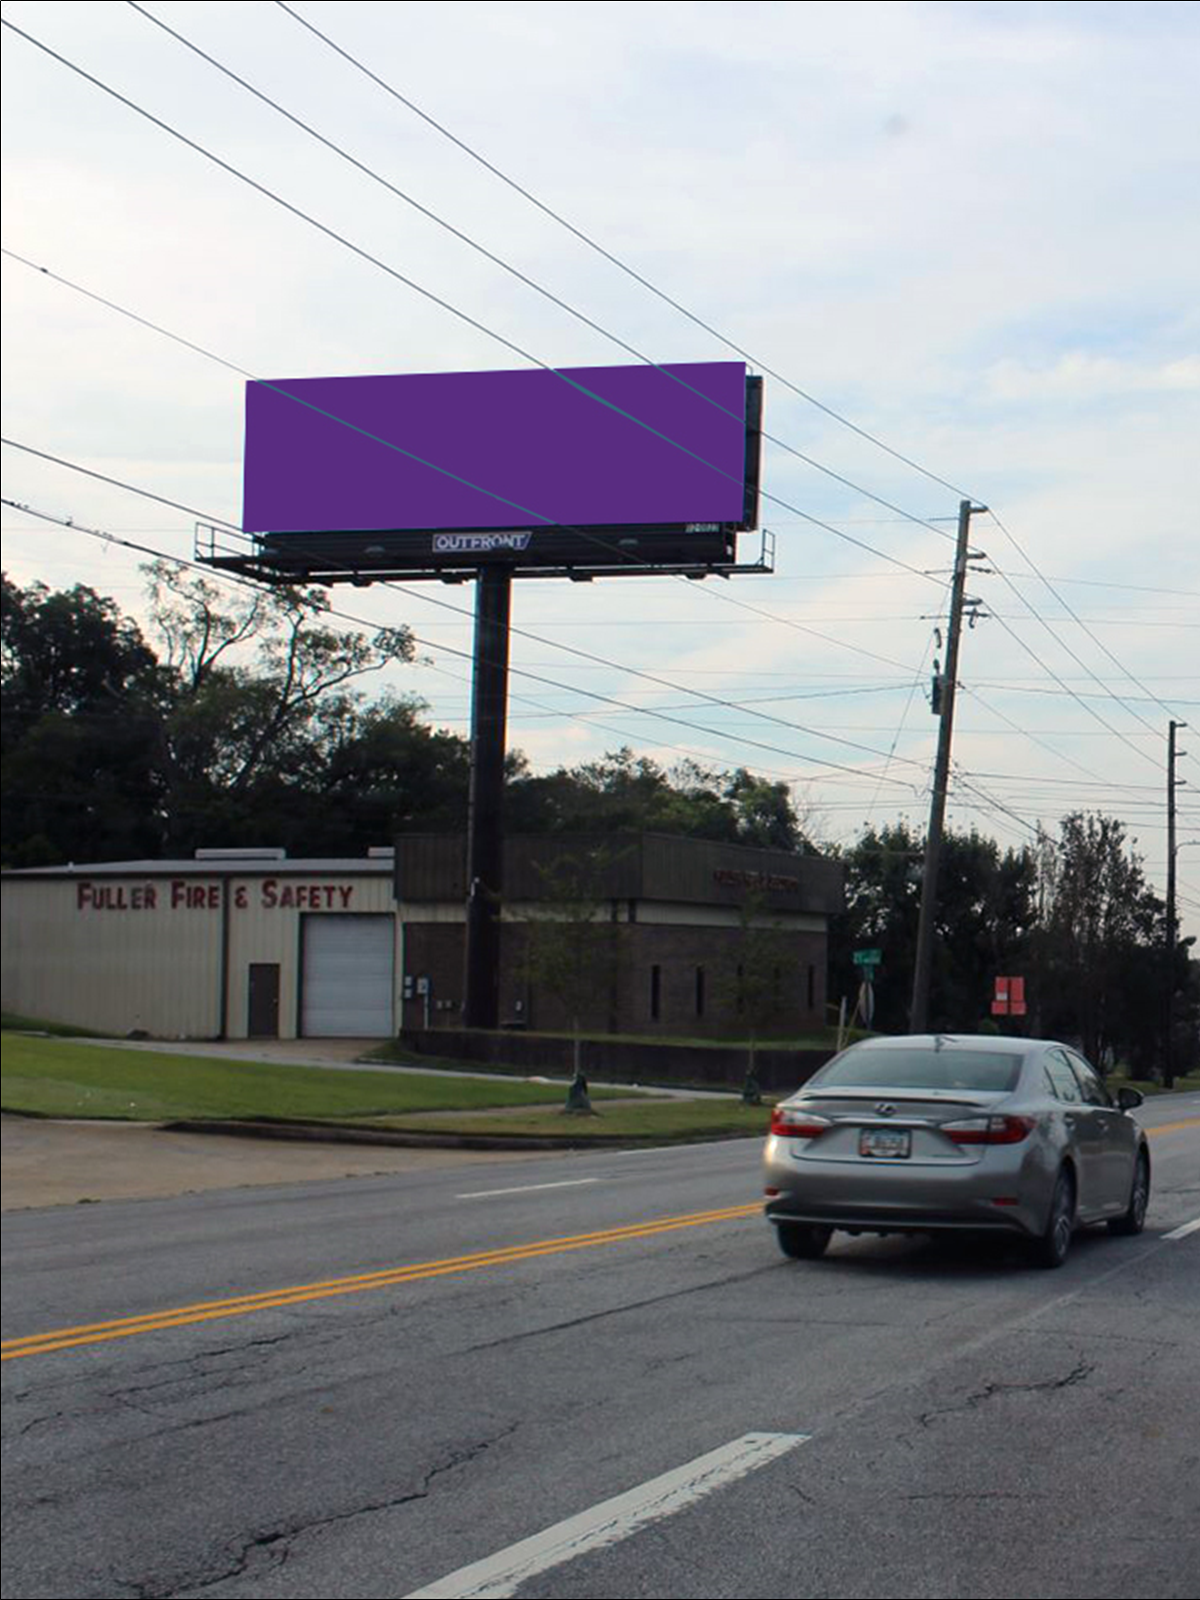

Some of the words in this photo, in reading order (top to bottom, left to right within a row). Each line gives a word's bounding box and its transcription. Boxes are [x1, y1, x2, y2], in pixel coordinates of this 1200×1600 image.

[437, 534, 525, 549] OUTFRONT
[77, 883, 156, 911] FULLER
[170, 881, 219, 910] FIRE
[235, 885, 248, 909] &
[261, 880, 354, 910] SAFETY
